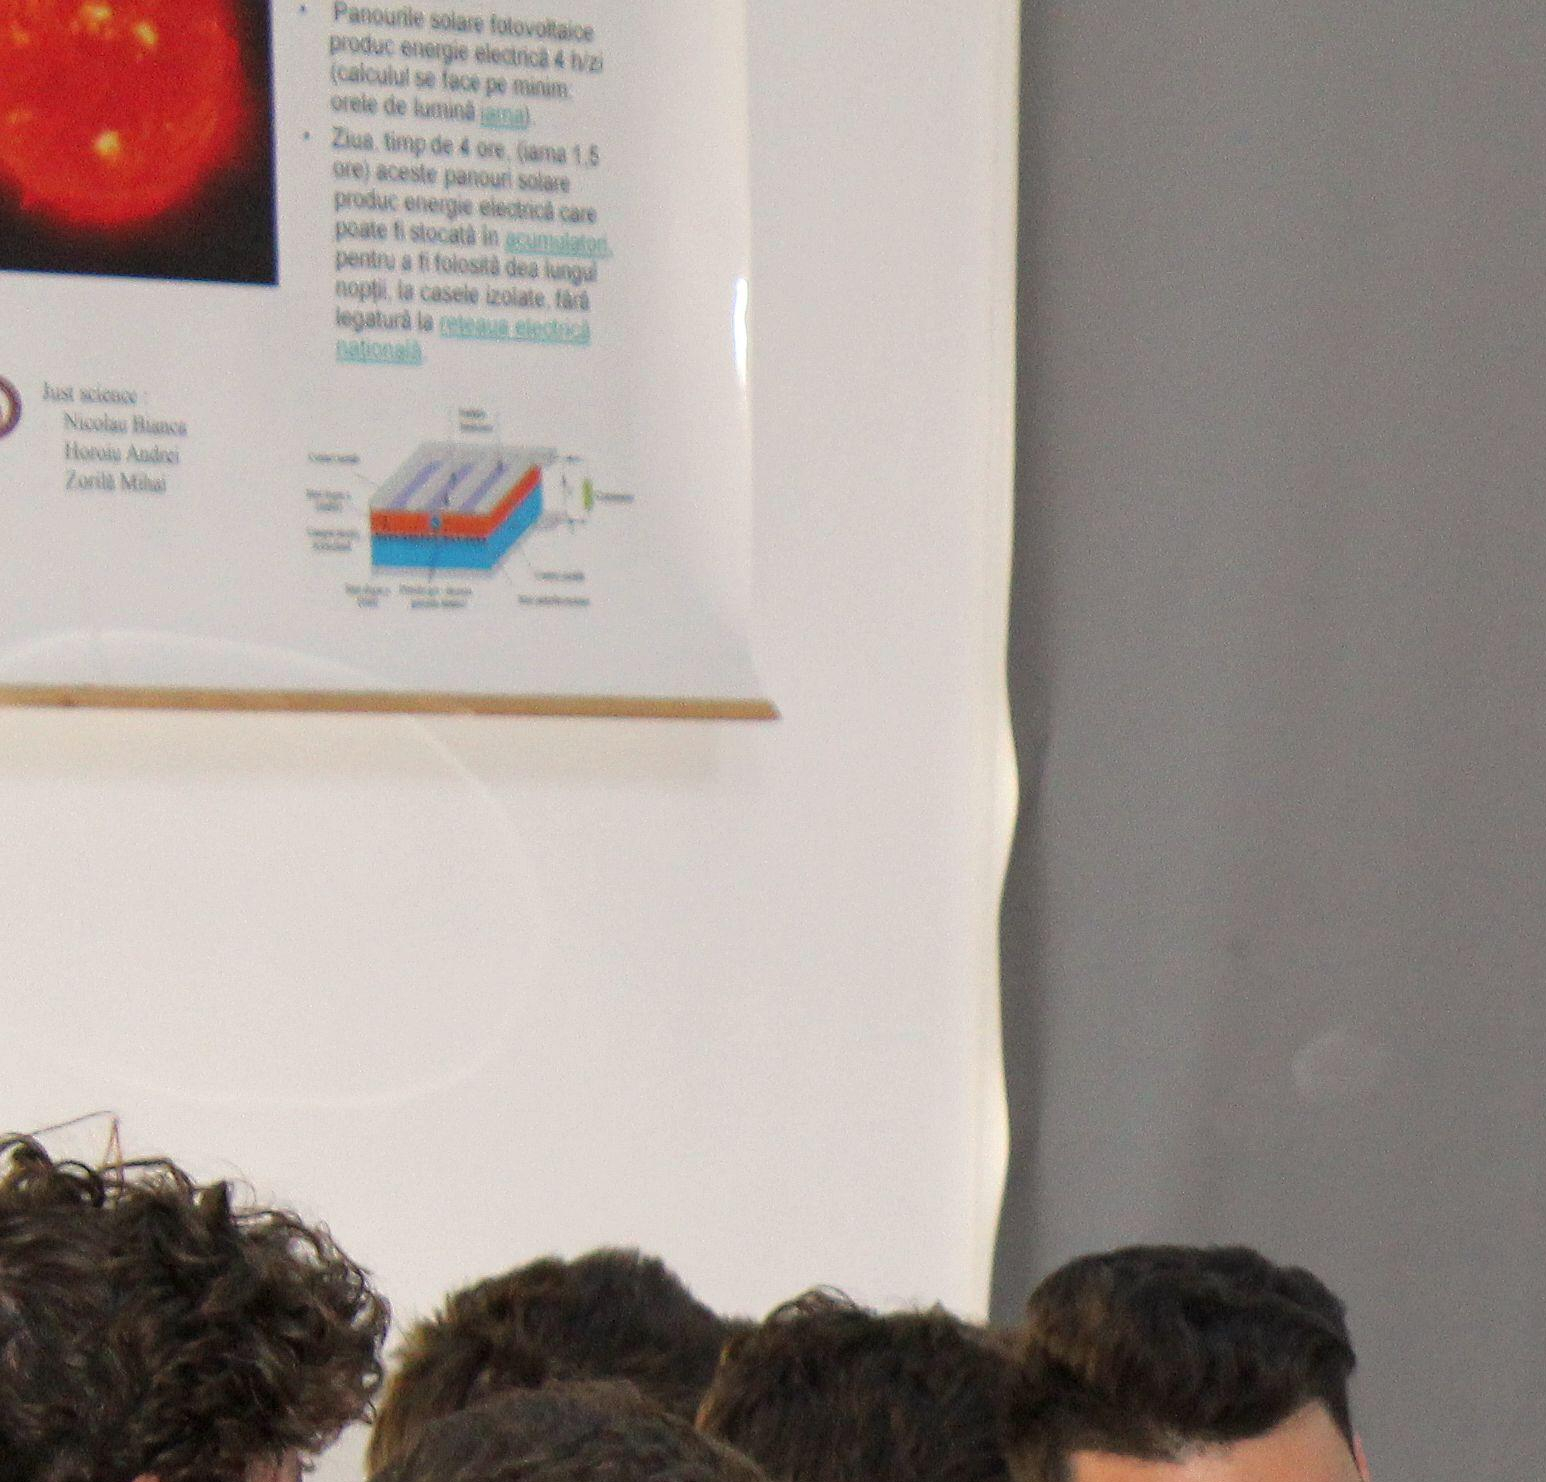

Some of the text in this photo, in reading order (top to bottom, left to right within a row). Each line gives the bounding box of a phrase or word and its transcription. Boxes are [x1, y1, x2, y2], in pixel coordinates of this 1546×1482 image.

[430, 11, 484, 34] solare
[489, 13, 594, 43] fotovoltaice
[329, 34, 394, 57] produc
[401, 38, 468, 65] energie
[415, 69, 436, 88] se
[441, 69, 480, 92] face
[486, 75, 507, 97] pe
[330, 93, 378, 115] orele
[383, 95, 407, 117] de
[383, 131, 427, 157] timp
[430, 134, 453, 155] de
[332, 159, 570, 193] ore) aceste panouri solare
[334, 188, 395, 212] produc
[404, 193, 474, 219] energie
[559, 204, 598, 224] care
[336, 219, 388, 242] poate
[393, 219, 405, 241] fi
[335, 250, 395, 272] pentru
[418, 251, 430, 271] fi
[543, 259, 598, 286] lungul
[398, 278, 414, 301] la
[419, 283, 480, 305] casele
[417, 309, 434, 332] la
[43, 381, 74, 402] Just
[80, 384, 138, 404] science
[132, 415, 188, 438] Bianca
[126, 443, 180, 465] Andrei
[120, 471, 167, 494] Mihai
